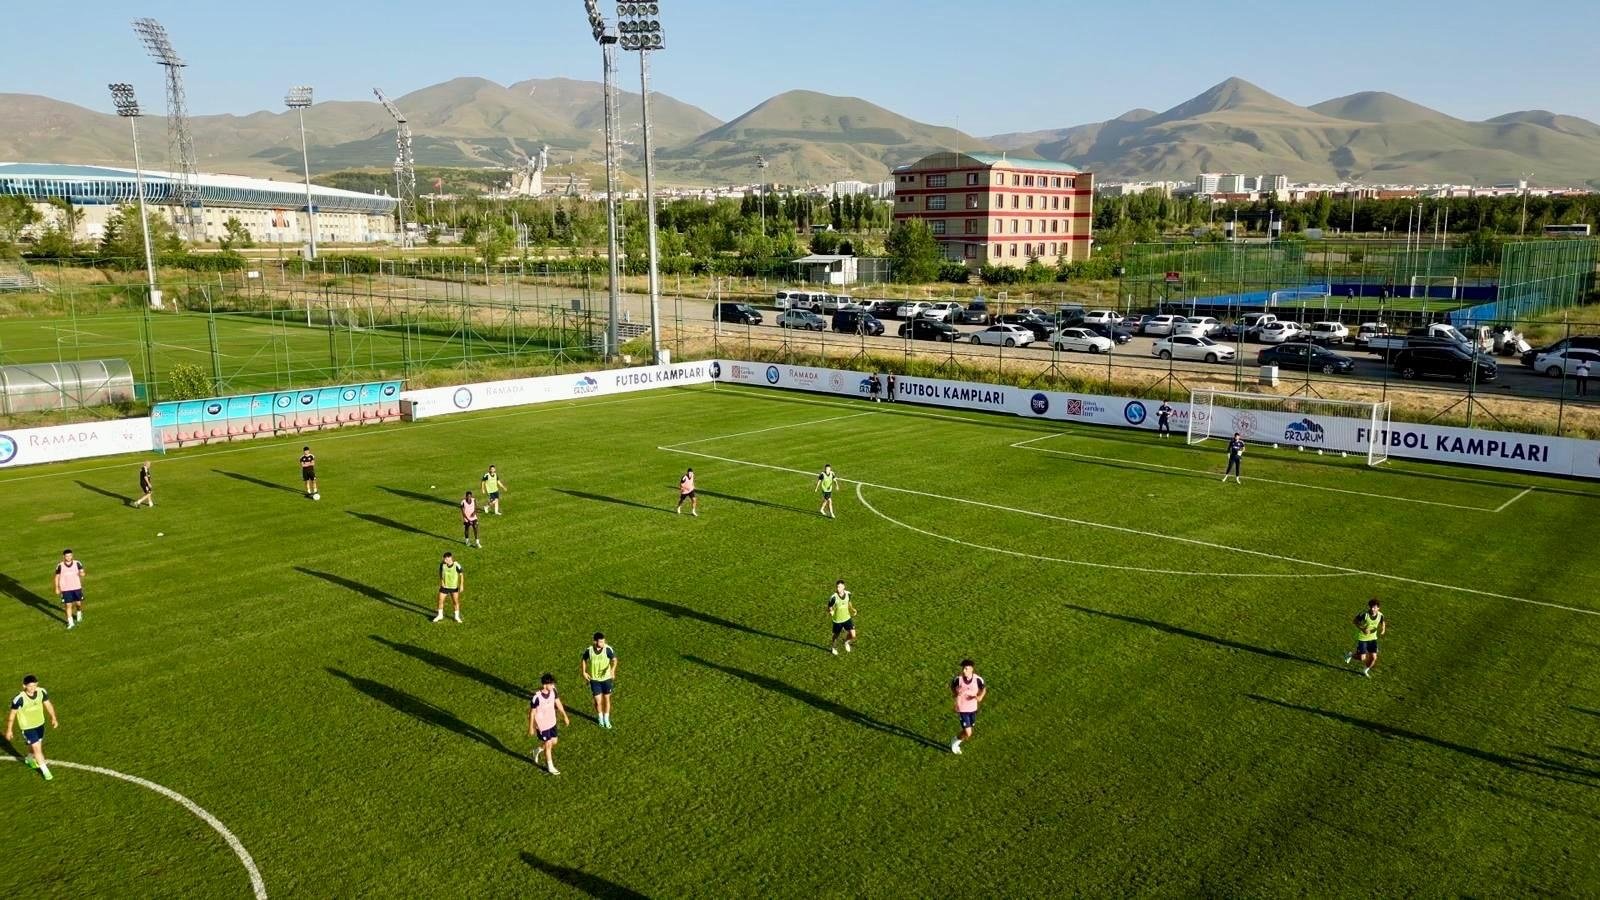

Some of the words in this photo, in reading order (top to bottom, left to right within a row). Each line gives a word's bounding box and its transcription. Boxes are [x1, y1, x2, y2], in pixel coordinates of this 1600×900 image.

[616, 373, 653, 387] FUTBOL
[656, 367, 704, 382] KAMPLARI
[789, 368, 819, 380] RAMADA
[486, 385, 525, 397] RAMADA
[900, 382, 940, 398] FUTBOL
[943, 386, 1004, 404] KAMPLARI
[1082, 404, 1105, 413] Garden
[1171, 409, 1214, 421] AMADA
[29, 431, 99, 448] RAMADA
[1284, 429, 1324, 443] ERZURUM
[1436, 435, 1549, 463] KAMPLARI
